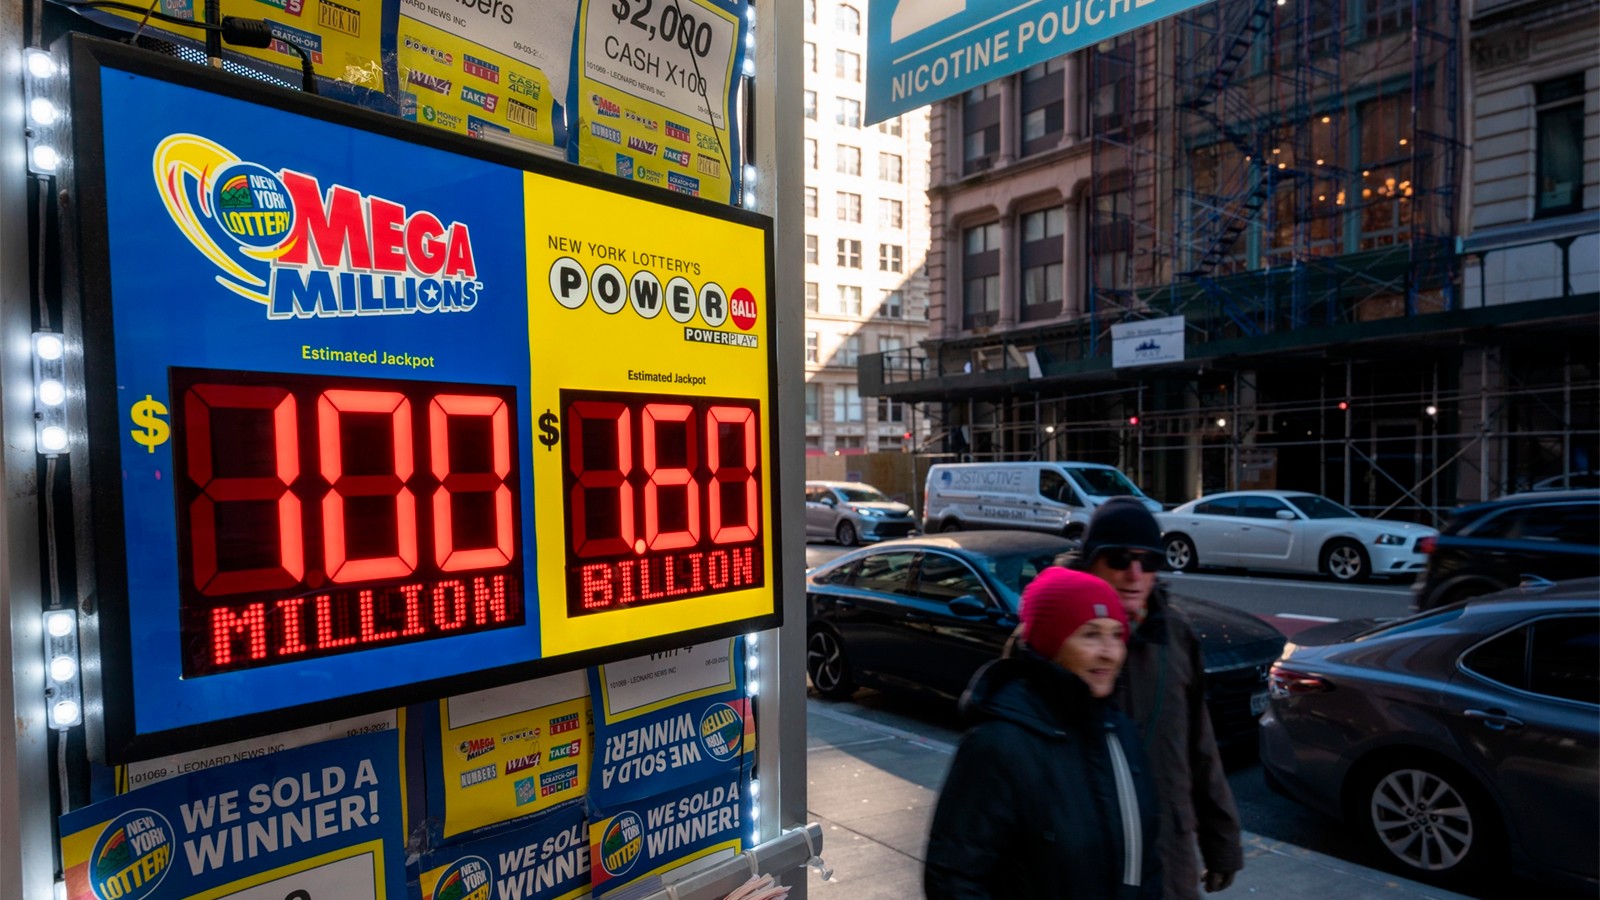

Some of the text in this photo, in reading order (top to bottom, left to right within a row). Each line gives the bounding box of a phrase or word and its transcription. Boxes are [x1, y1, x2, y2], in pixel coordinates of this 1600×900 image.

[321, 5, 358, 34] PICK 10
[402, 0, 467, 28] NARD NEWS INC
[271, 29, 319, 49] CRATCH-OFF
[612, 0, 712, 58] $2,000
[404, 38, 445, 60] POWER
[892, 29, 1010, 102] NICOTINE
[1018, 0, 1156, 54] POUCH
[604, 36, 707, 97] CASH X100
[411, 70, 450, 96] WIN 4
[508, 74, 541, 92] CASH
[508, 84, 540, 100] 4LIFE
[610, 70, 638, 88] LEONARD
[656, 88, 666, 98] INC
[462, 88, 496, 110] TAKE 5
[600, 97, 620, 115] MEGA
[436, 110, 462, 124] MONEY
[436, 118, 456, 129] DOTS
[508, 105, 526, 123] PICK
[592, 122, 620, 144] NUMBERS
[630, 137, 648, 150] WIN
[664, 149, 682, 162] TAKE
[682, 152, 689, 165] 5
[250, 174, 277, 191] NEW
[646, 169, 664, 178] MONEY
[646, 175, 660, 184] DOTS
[670, 176, 698, 188] SCRATCH-OFF
[254, 189, 286, 210] YORK
[222, 211, 290, 237] LOTTERY
[277, 170, 476, 277] MEGA
[548, 235, 701, 276] NEW YORK LOTTERY'S
[273, 268, 477, 315] MILLIONS
[302, 345, 435, 369] Estimated Jackpot
[628, 370, 706, 386] Estimated Jackpot
[130, 395, 170, 454] $
[538, 409, 560, 452] $
[273, 388, 514, 584] 100
[617, 403, 758, 555] 1.60
[955, 470, 1023, 486] DISTINCTIVE
[583, 547, 752, 609] BILLION
[212, 575, 506, 665] MILLION
[630, 672, 654, 684] LEONARD
[654, 670, 668, 679] NEWS
[668, 667, 677, 676] INC
[346, 721, 390, 738] 10-13-2021
[550, 720, 580, 735] LOTTO
[702, 708, 737, 736] LOTTERY
[468, 737, 495, 753] MEGA
[502, 730, 534, 744] POWER
[604, 712, 696, 765] WINNER!
[705, 732, 725, 748] YORK
[508, 752, 540, 770] WIN 4
[550, 743, 580, 758] TAKE 5
[670, 741, 702, 769] WE
[712, 744, 729, 756] NEW
[128, 768, 167, 785] 101069
[177, 753, 232, 775] LEONARD
[233, 747, 266, 763] NEWS
[267, 744, 286, 754] INC
[618, 752, 667, 784] SOLD
[461, 766, 496, 786] NUMBERS
[542, 770, 576, 786] SCRATCH-OFF
[602, 766, 616, 790] A
[180, 758, 379, 834] WE SOLD A
[647, 781, 740, 830] WE SOLD A
[126, 815, 155, 836] NEW
[184, 790, 380, 876] WINNER!
[620, 816, 635, 829] NEW
[647, 803, 740, 860] WINNER!
[130, 826, 166, 856] YORK
[622, 825, 640, 843] YORK
[498, 842, 538, 876] WE
[605, 834, 642, 871] LOTTERY
[99, 842, 170, 900] LOTTERY
[461, 861, 481, 878] NEW
[498, 846, 590, 900] WINNE
[463, 870, 487, 893] YORK
